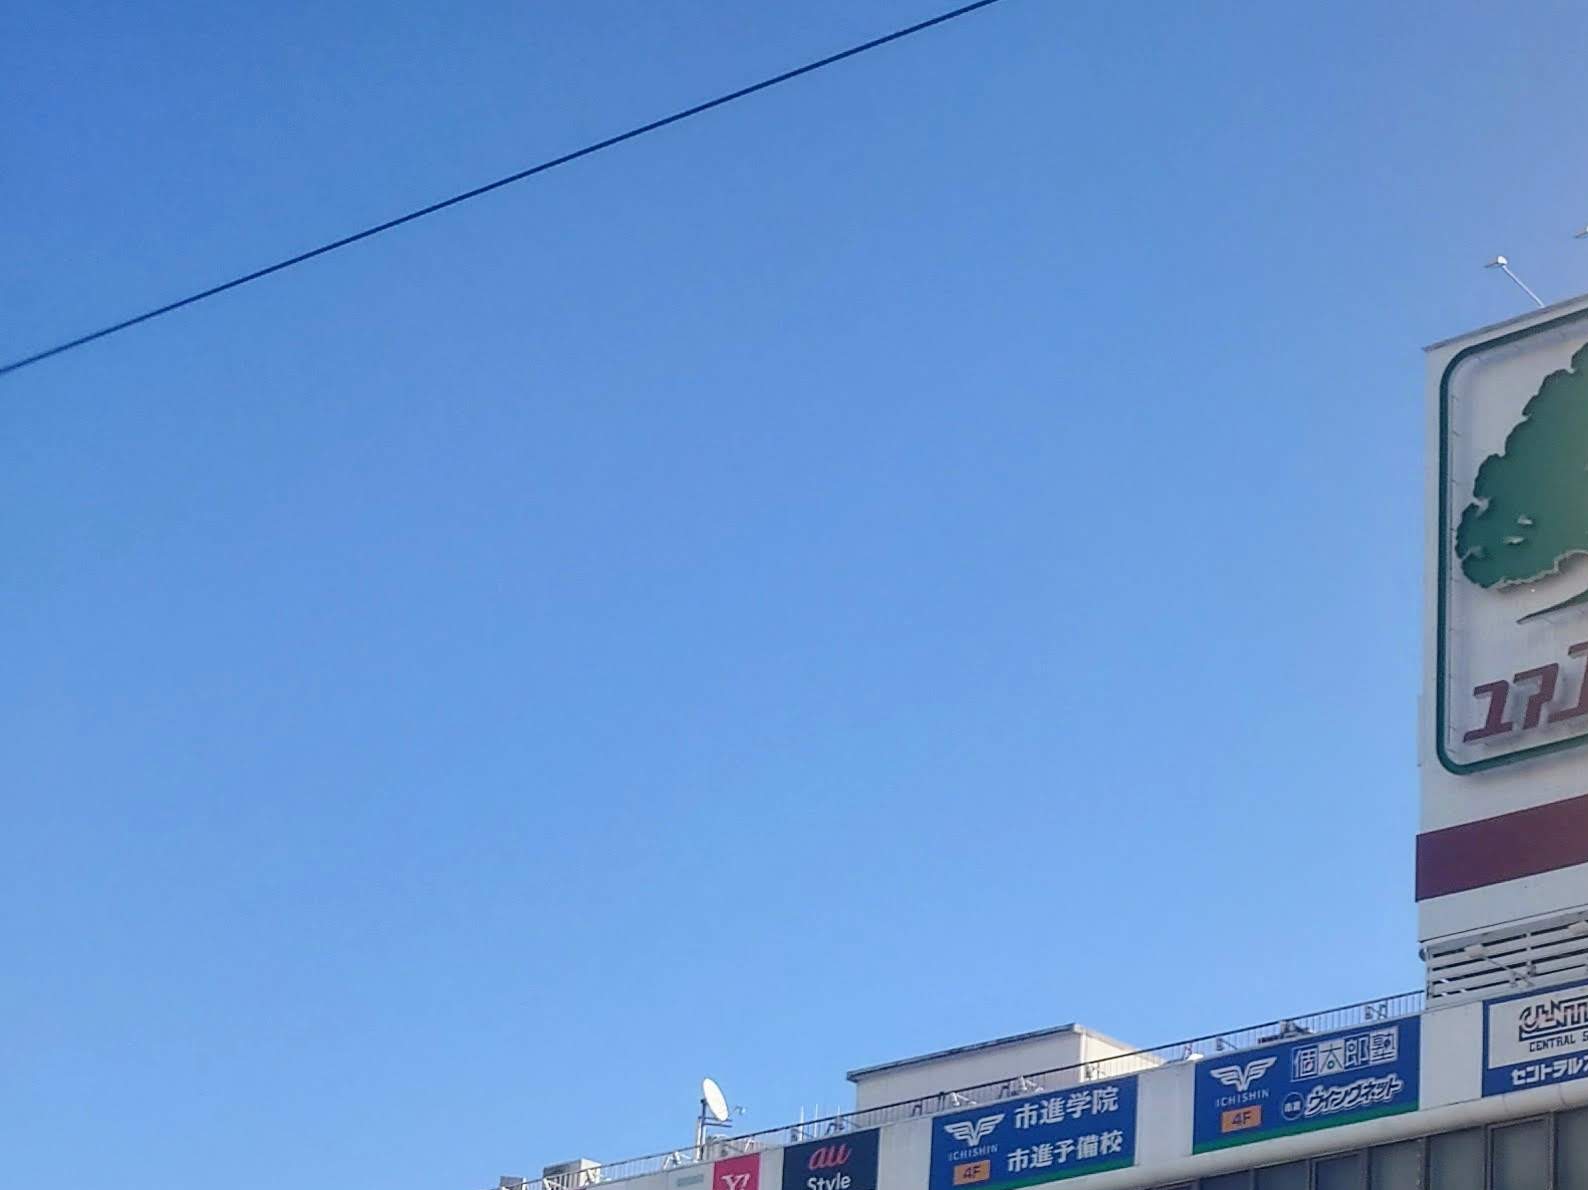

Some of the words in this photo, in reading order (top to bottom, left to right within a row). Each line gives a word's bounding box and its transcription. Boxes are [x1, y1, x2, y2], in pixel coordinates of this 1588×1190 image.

[1529, 1034, 1576, 1053] CENTRAL
[1216, 1087, 1270, 1108] ICHISHIN
[1013, 1086, 1120, 1130] 市進学院
[1231, 1110, 1252, 1126] 4F
[808, 1143, 850, 1171] au
[949, 1143, 999, 1162] ICHISHIN
[1007, 1129, 1124, 1173] 市進予備校
[962, 1164, 982, 1180] 4F
